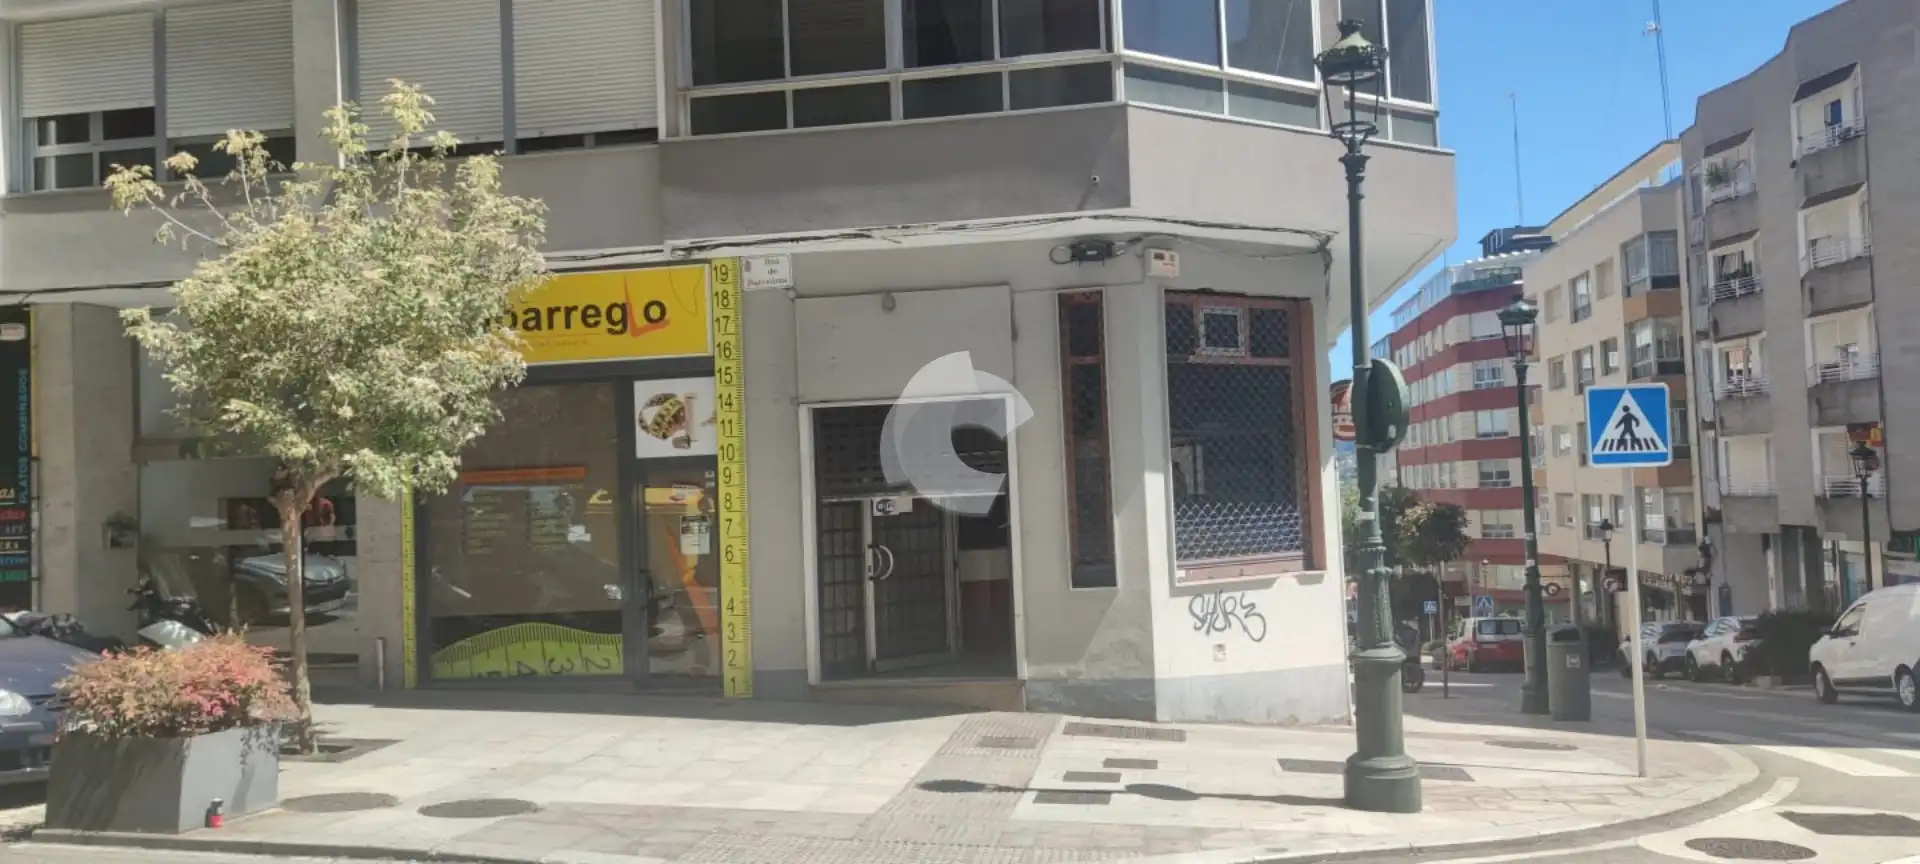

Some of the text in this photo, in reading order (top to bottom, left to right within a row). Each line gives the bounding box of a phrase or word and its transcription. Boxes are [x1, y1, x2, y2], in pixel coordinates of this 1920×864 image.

[713, 264, 729, 283] 19
[714, 290, 730, 309] 18
[714, 315, 731, 334] 17
[715, 341, 732, 360] 16
[717, 366, 733, 385] 15
[718, 392, 733, 410] 14
[719, 418, 733, 437] 11
[719, 443, 735, 461] 10
[723, 466, 732, 485] 9
[724, 492, 733, 511] 8
[724, 518, 733, 536] 7
[724, 543, 734, 562] 6
[725, 597, 735, 613] 4
[726, 622, 736, 641] 3
[727, 650, 737, 667] 2
[729, 676, 736, 695] 1
